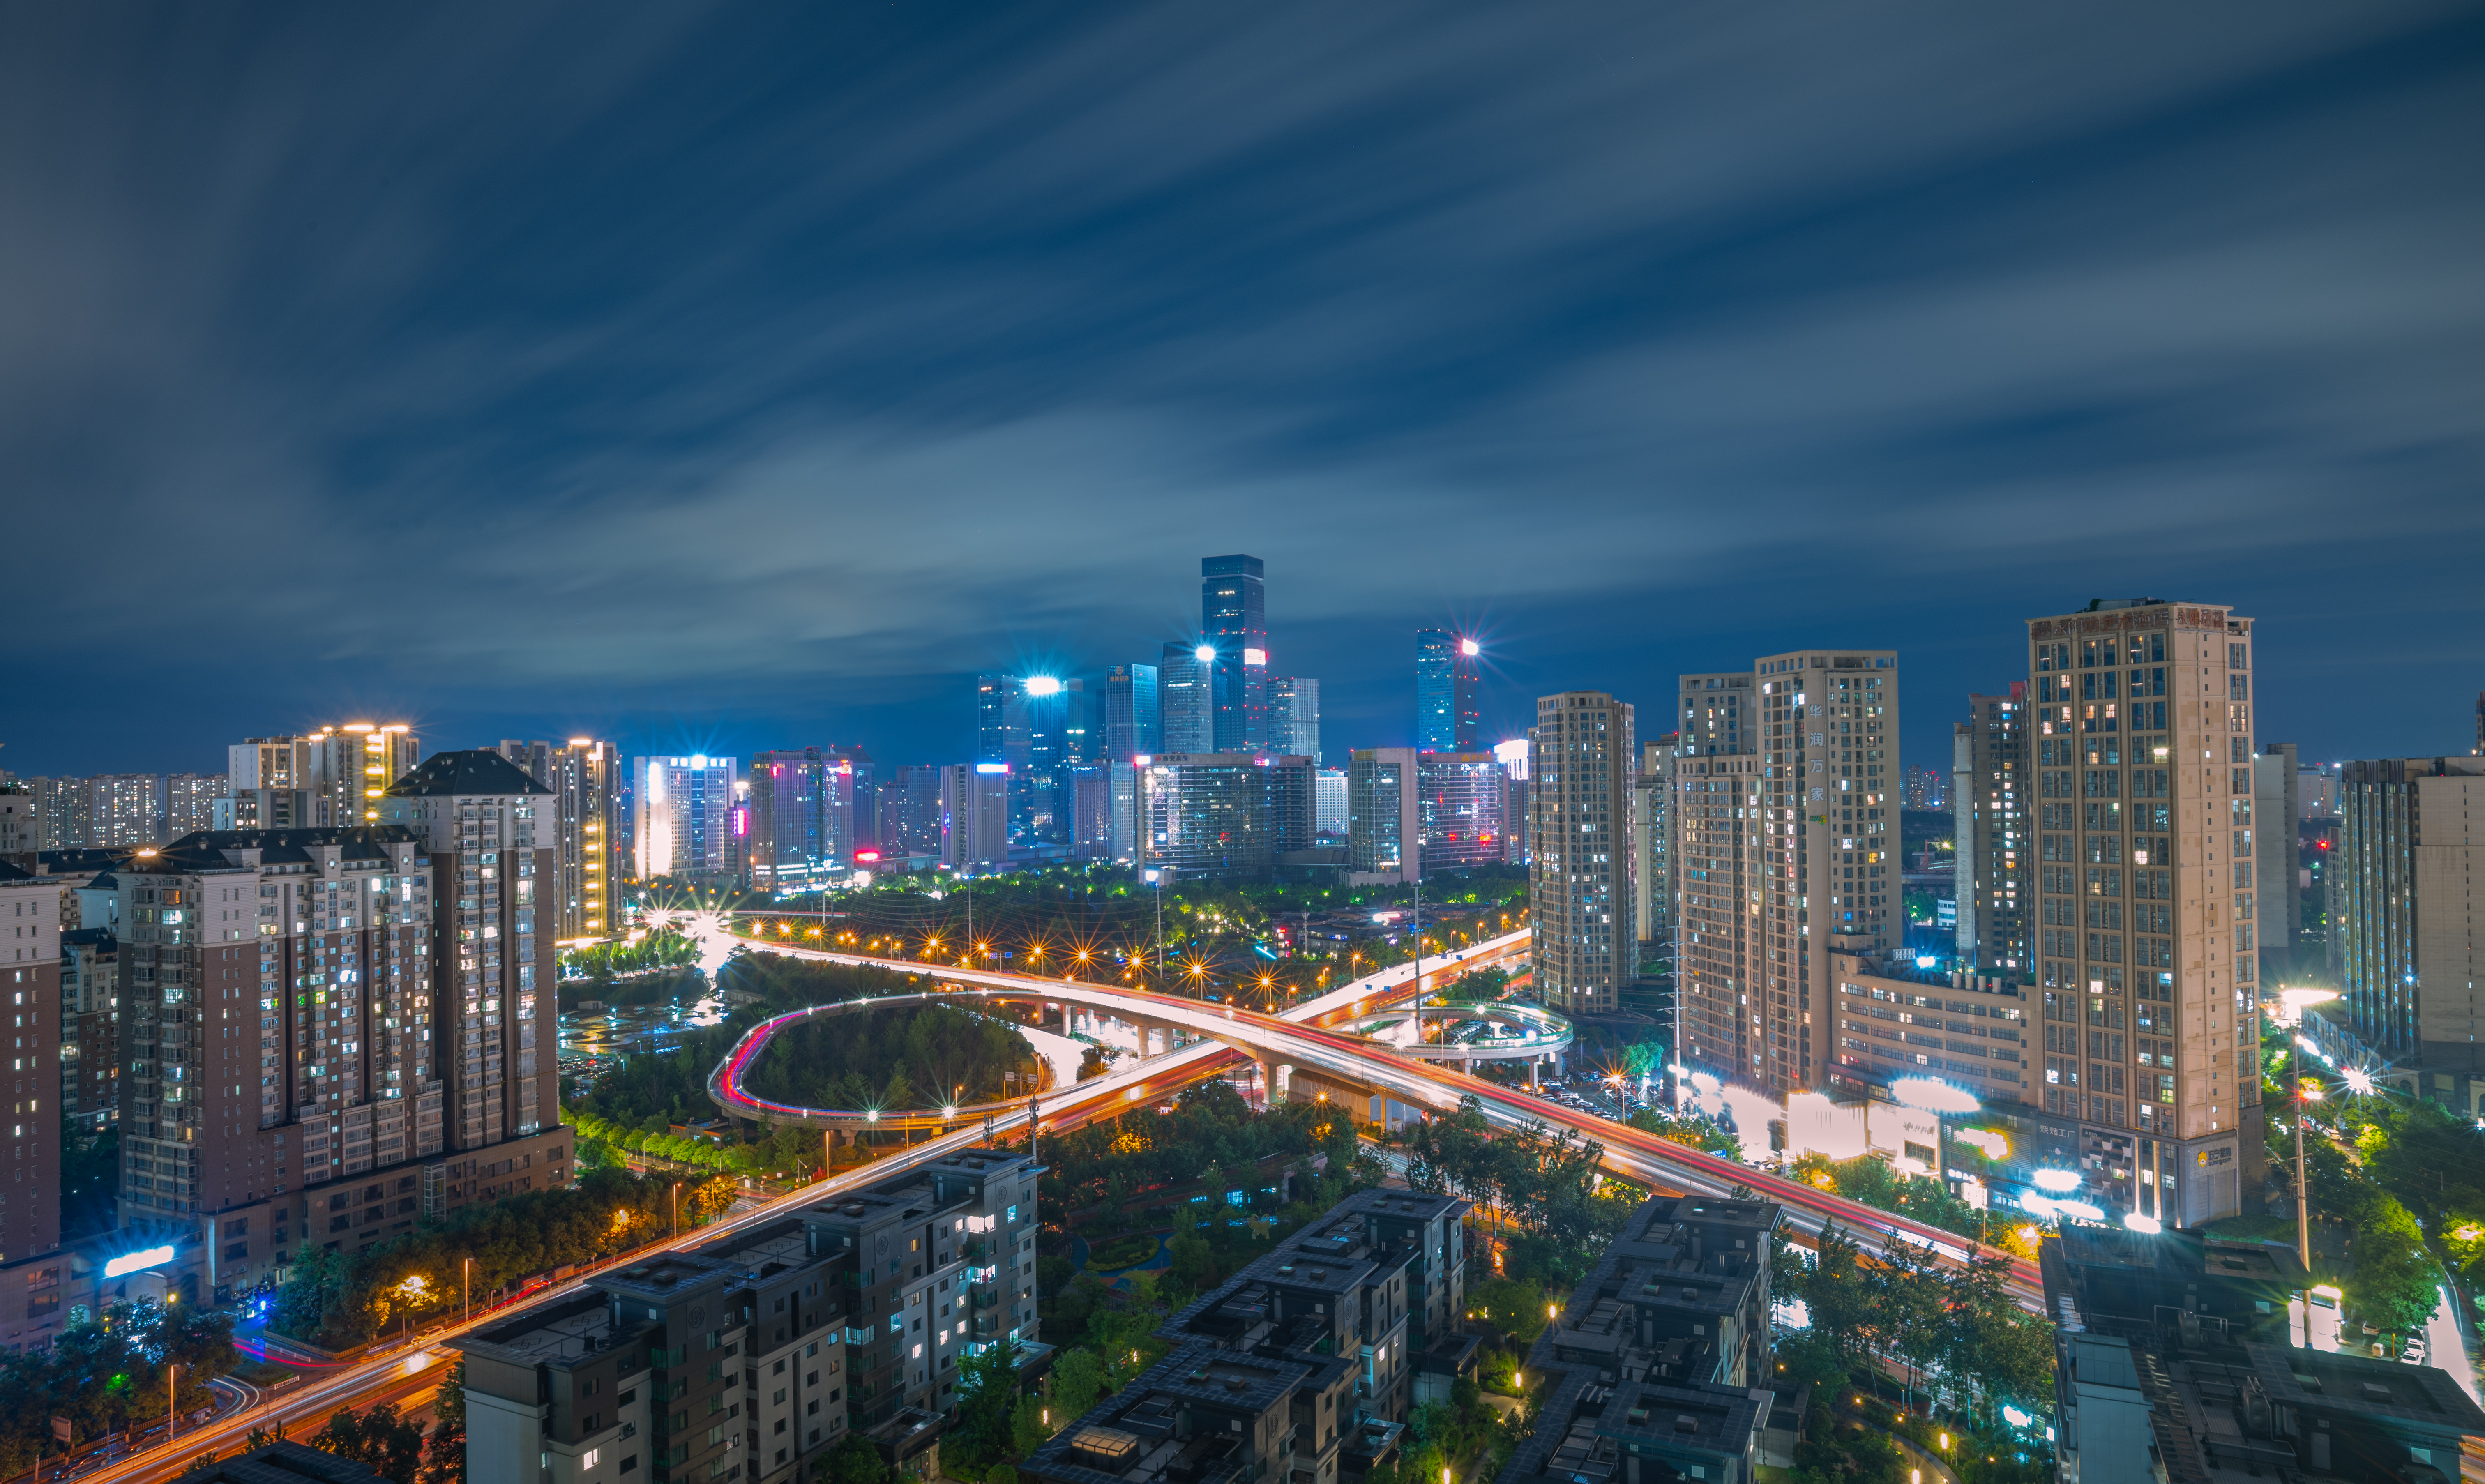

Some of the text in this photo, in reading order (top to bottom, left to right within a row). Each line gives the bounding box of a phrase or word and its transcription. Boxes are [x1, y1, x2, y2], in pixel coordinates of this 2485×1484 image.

[1809, 704, 1824, 801] 华润万家
[2040, 1125, 2075, 1138] 烧烤工厂
[2208, 1147, 2231, 1161] 苏宁易购
[2208, 1157, 2231, 1166] suning.com
